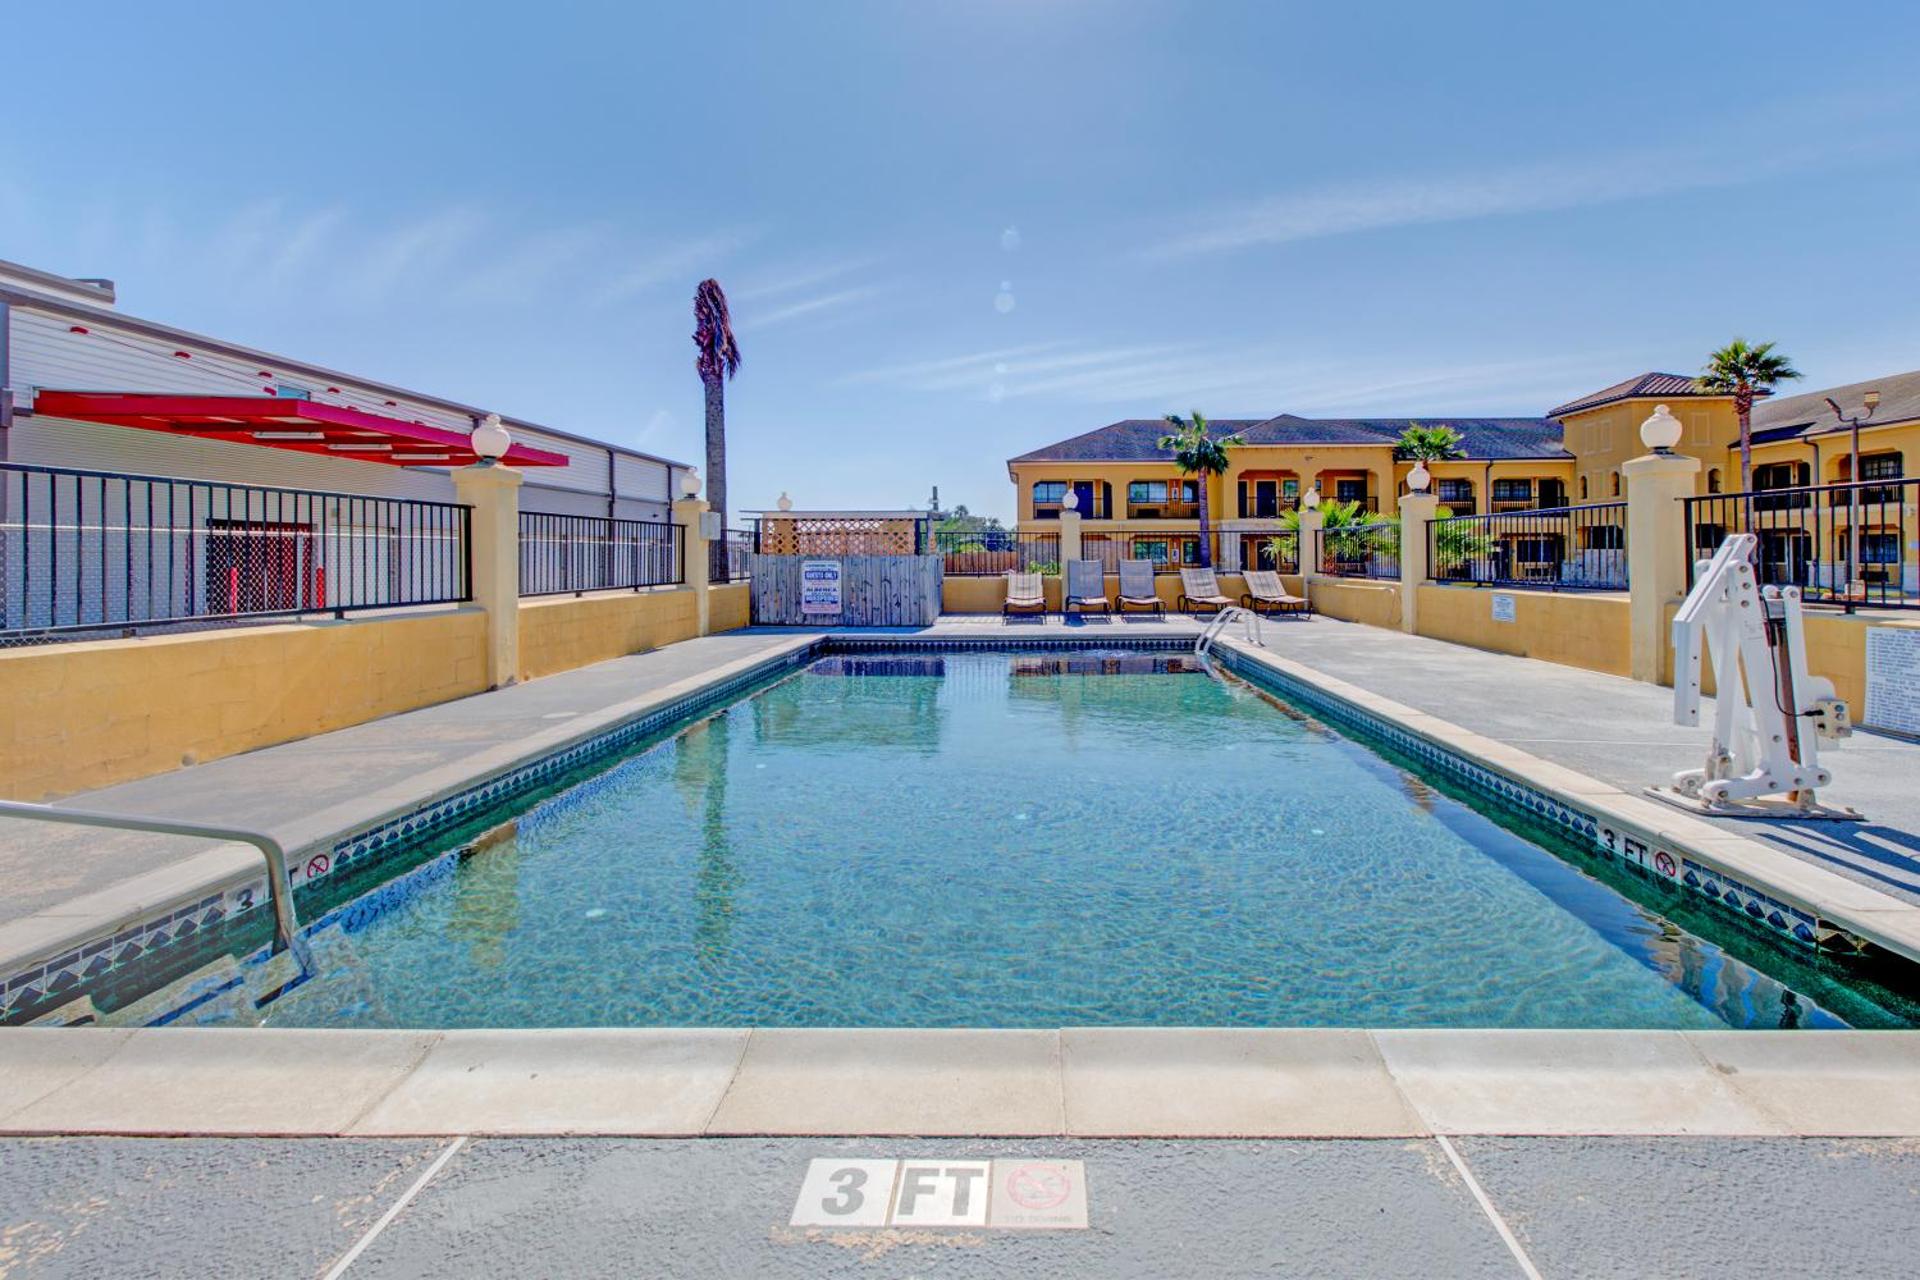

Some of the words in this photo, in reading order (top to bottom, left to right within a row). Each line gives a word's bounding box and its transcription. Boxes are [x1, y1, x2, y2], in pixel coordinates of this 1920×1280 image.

[1603, 828, 1616, 850] 3
[1624, 836, 1648, 864] FT
[236, 888, 254, 913] 3
[821, 1167, 868, 1216] 3
[897, 1167, 984, 1217] FT
